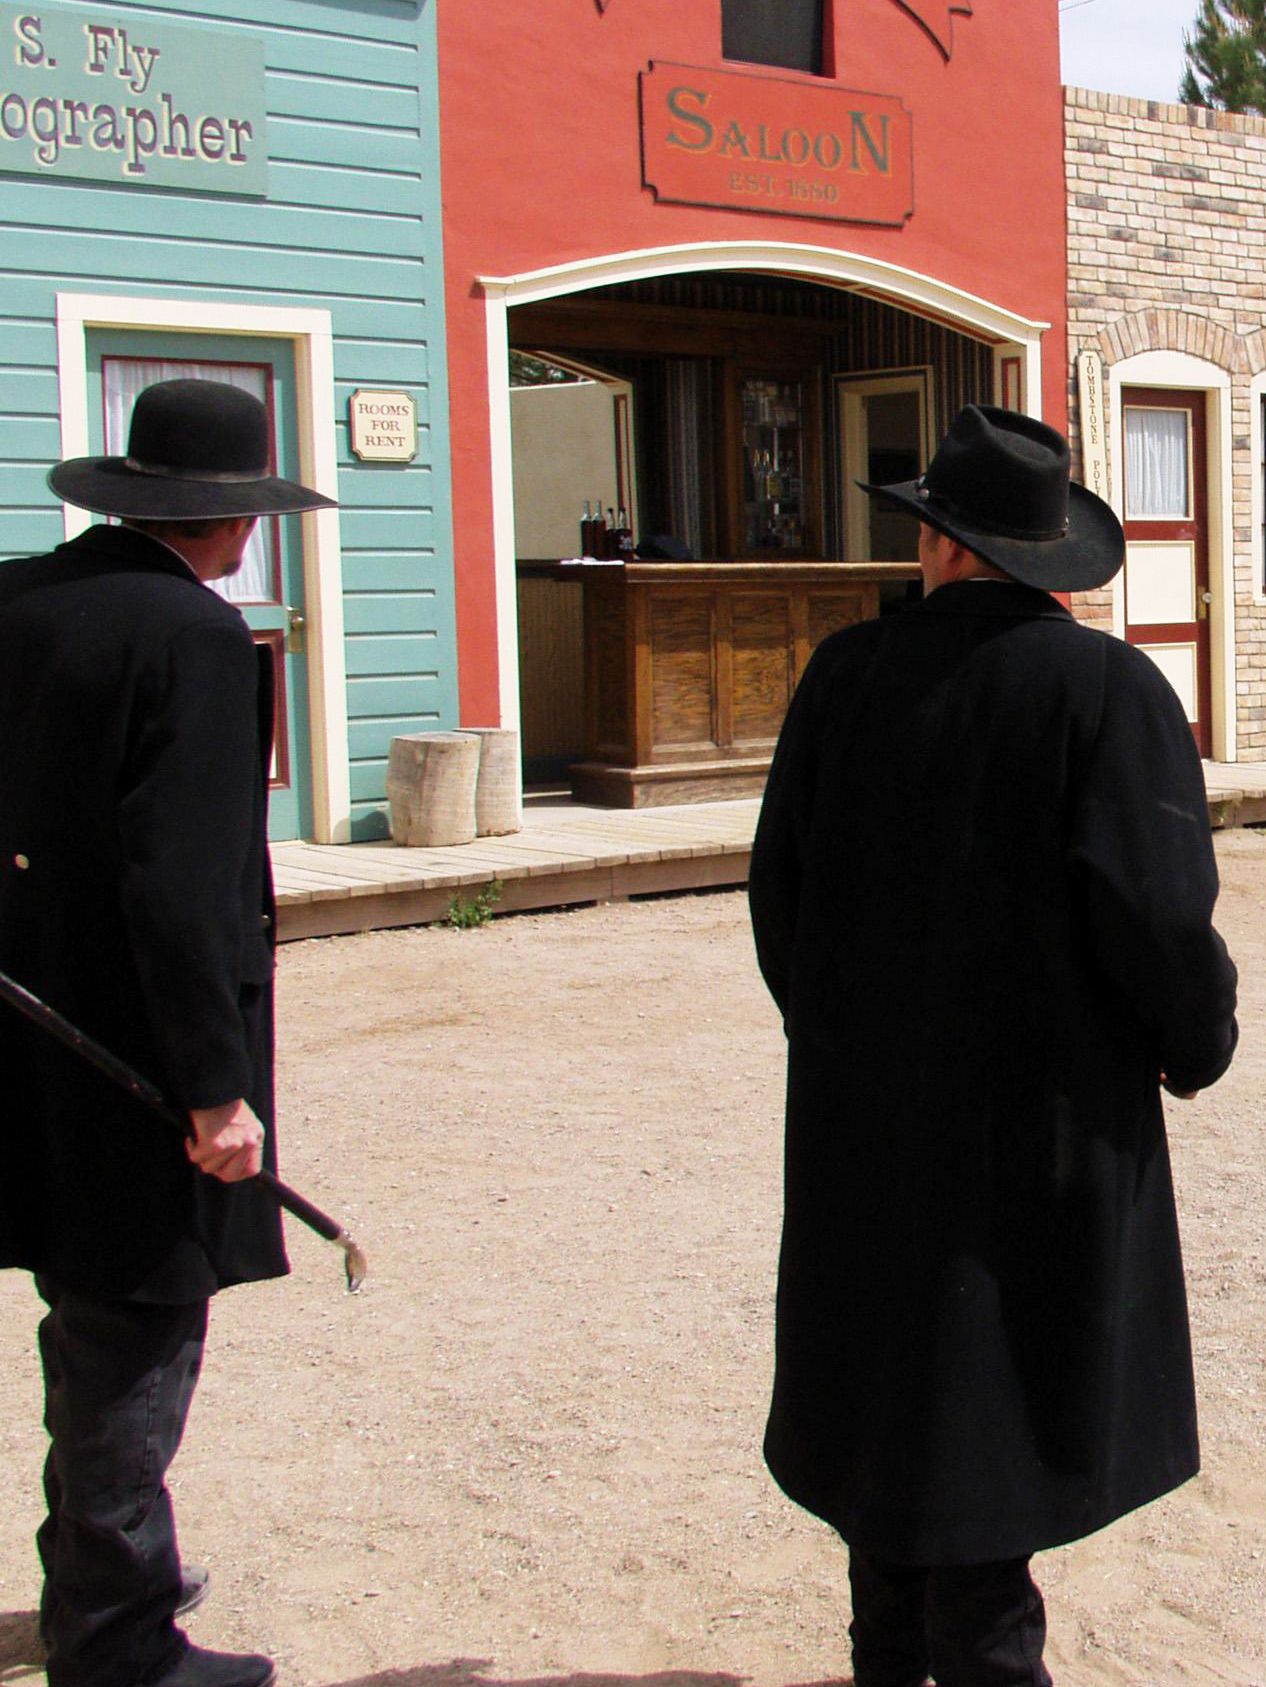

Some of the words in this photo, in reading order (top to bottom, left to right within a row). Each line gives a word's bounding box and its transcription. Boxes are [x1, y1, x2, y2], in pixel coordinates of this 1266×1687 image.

[15, 16, 57, 68] S.
[86, 24, 160, 93] Fly
[0, 93, 253, 174] ographer
[358, 403, 410, 416] ROOMS
[1085, 355, 1099, 444] TOMBSTONE
[365, 434, 406, 447] RENT
[371, 419, 401, 432] FOR
